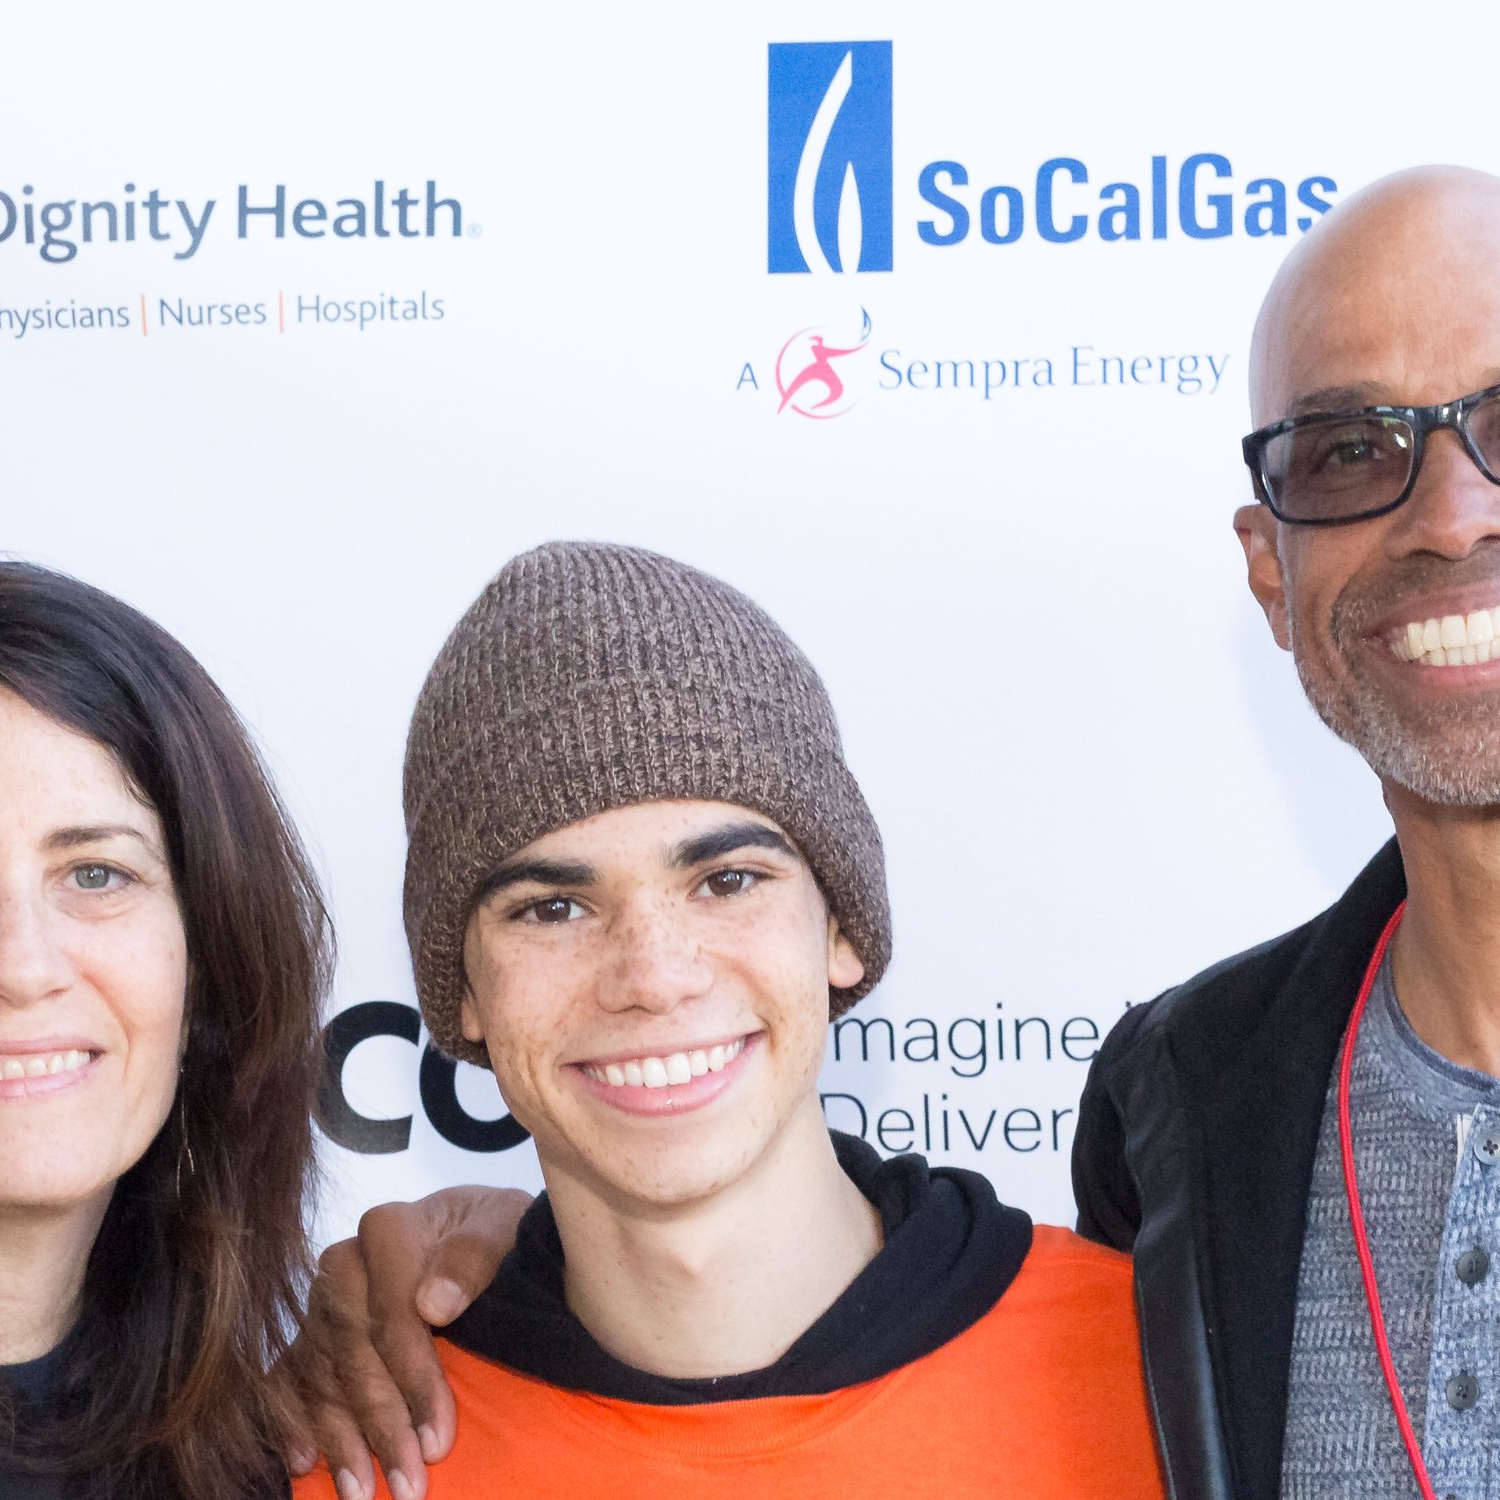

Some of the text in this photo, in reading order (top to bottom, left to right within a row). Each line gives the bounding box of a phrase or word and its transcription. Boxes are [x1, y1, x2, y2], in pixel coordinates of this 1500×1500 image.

[237, 179, 464, 240] Health
[917, 151, 1339, 247] SoCalGas
[159, 296, 268, 327] Nurses
[297, 290, 446, 332] Hospitals
[736, 344, 1232, 400] A Sempra Energy
